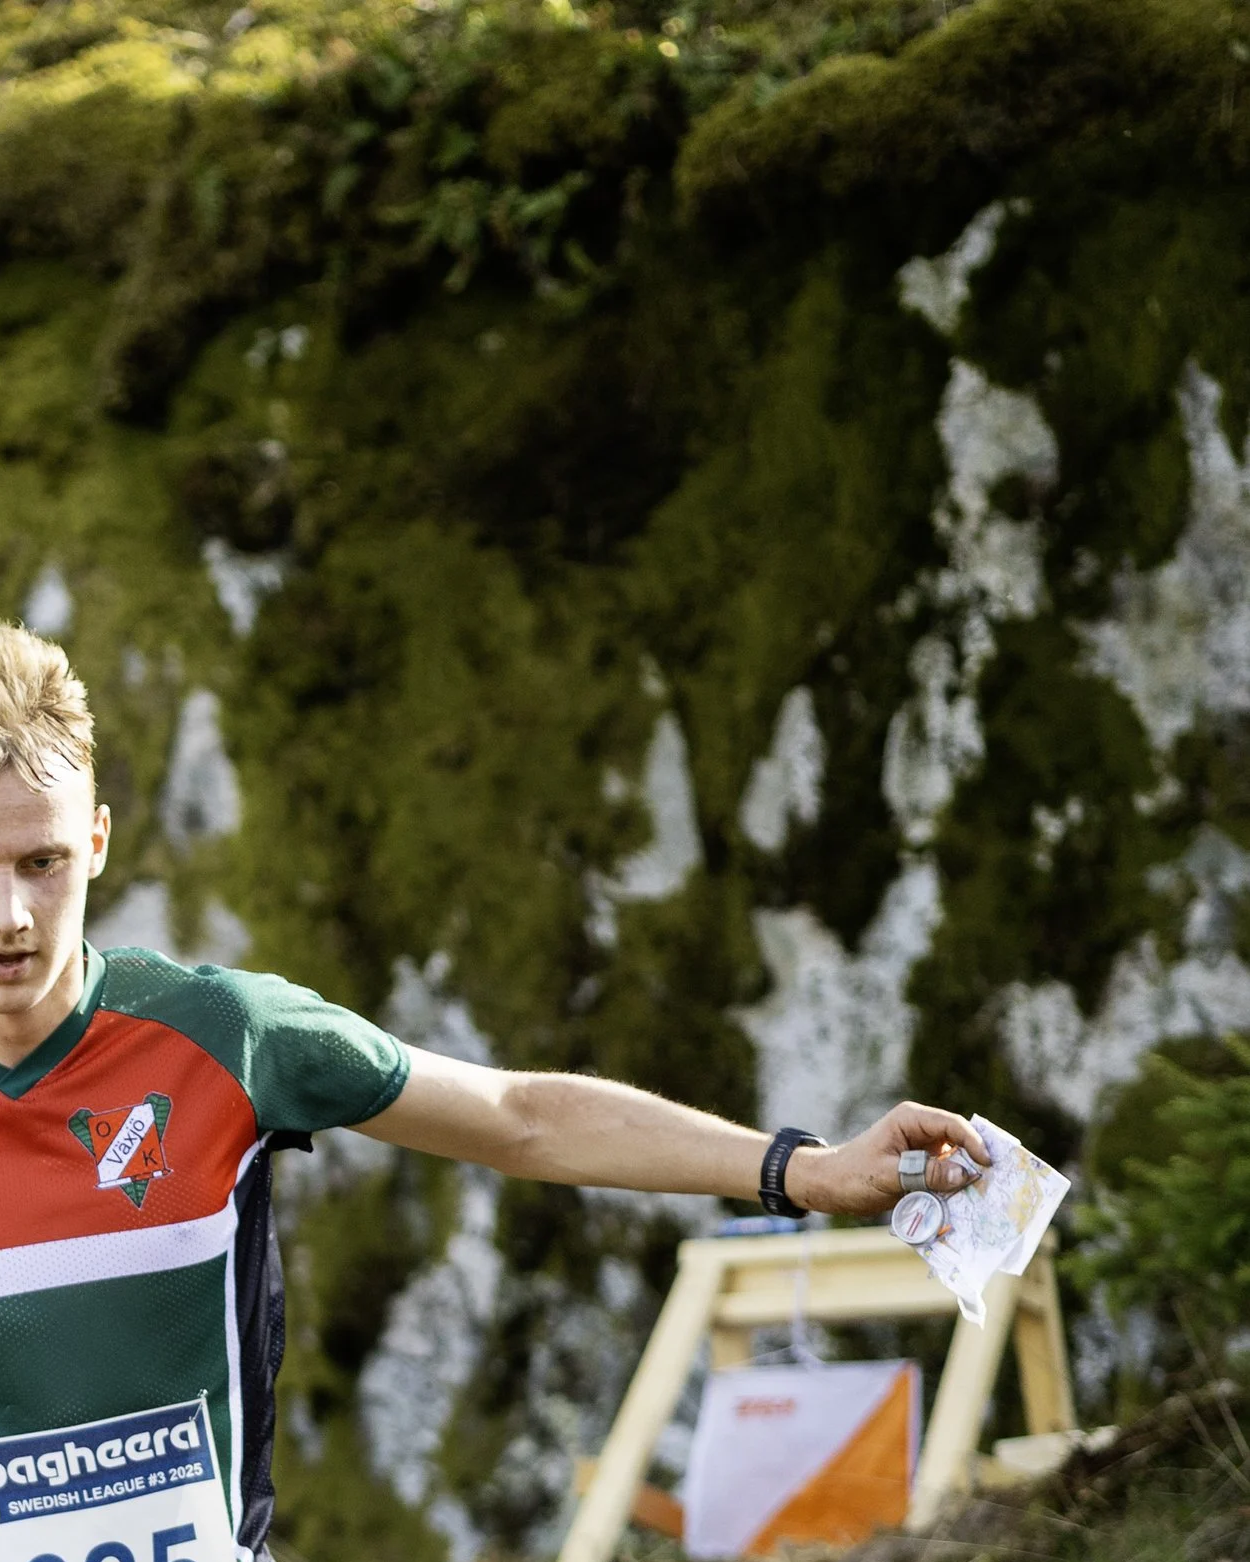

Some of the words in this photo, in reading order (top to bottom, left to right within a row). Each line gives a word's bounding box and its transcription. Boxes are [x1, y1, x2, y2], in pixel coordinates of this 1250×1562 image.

[95, 1120, 111, 1138] O
[106, 1118, 145, 1164] Växjö
[142, 1148, 158, 1167] K
[8, 1490, 80, 1515] SWEDISH
[83, 1476, 146, 1502] LEAGUE
[148, 1471, 166, 1487] #3
[170, 1462, 204, 1482] 2025
